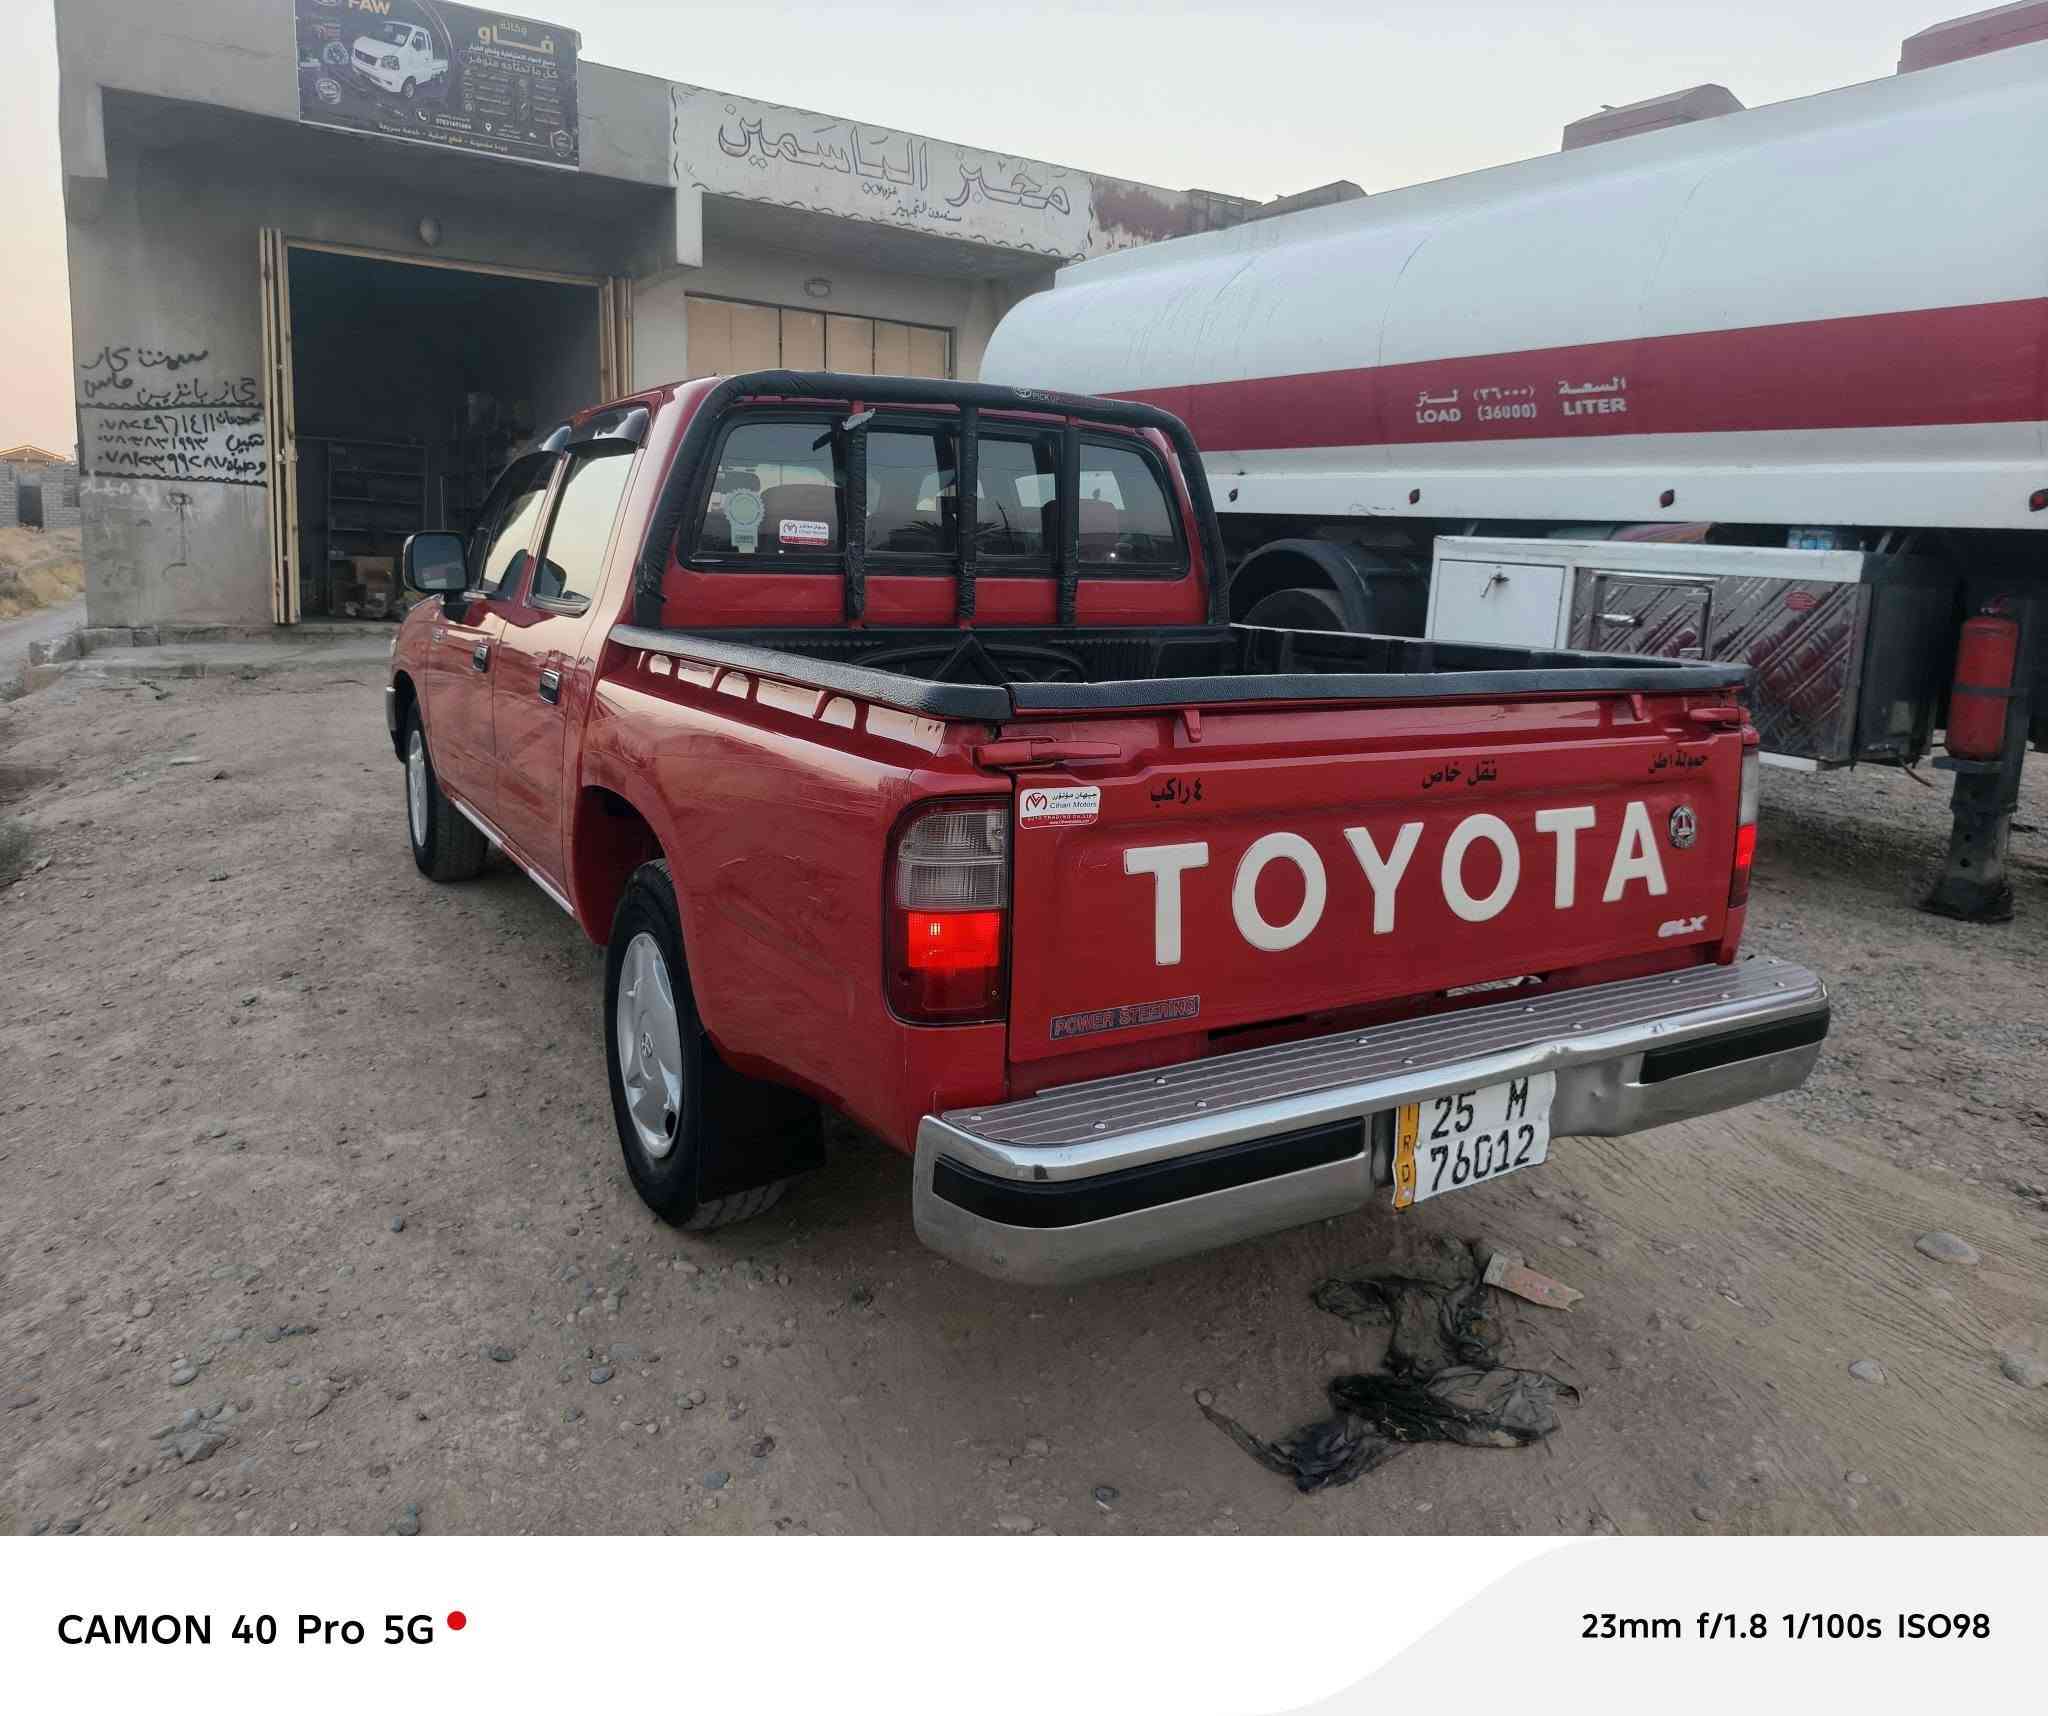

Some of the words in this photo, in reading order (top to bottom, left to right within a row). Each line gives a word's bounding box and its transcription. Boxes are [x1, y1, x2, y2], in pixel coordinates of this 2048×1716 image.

[1417, 408, 1461, 423] LOAD
[1477, 402, 1537, 421] (36000)
[1563, 398, 1627, 416] LITER
[1123, 801, 1669, 966] TOYOTA
[1054, 1012, 1114, 1037] POWER
[1119, 999, 1196, 1026] STEERING
[1430, 1090, 1476, 1140] 25
[1505, 1077, 1528, 1121] M
[1430, 1124, 1535, 1191] 76012
